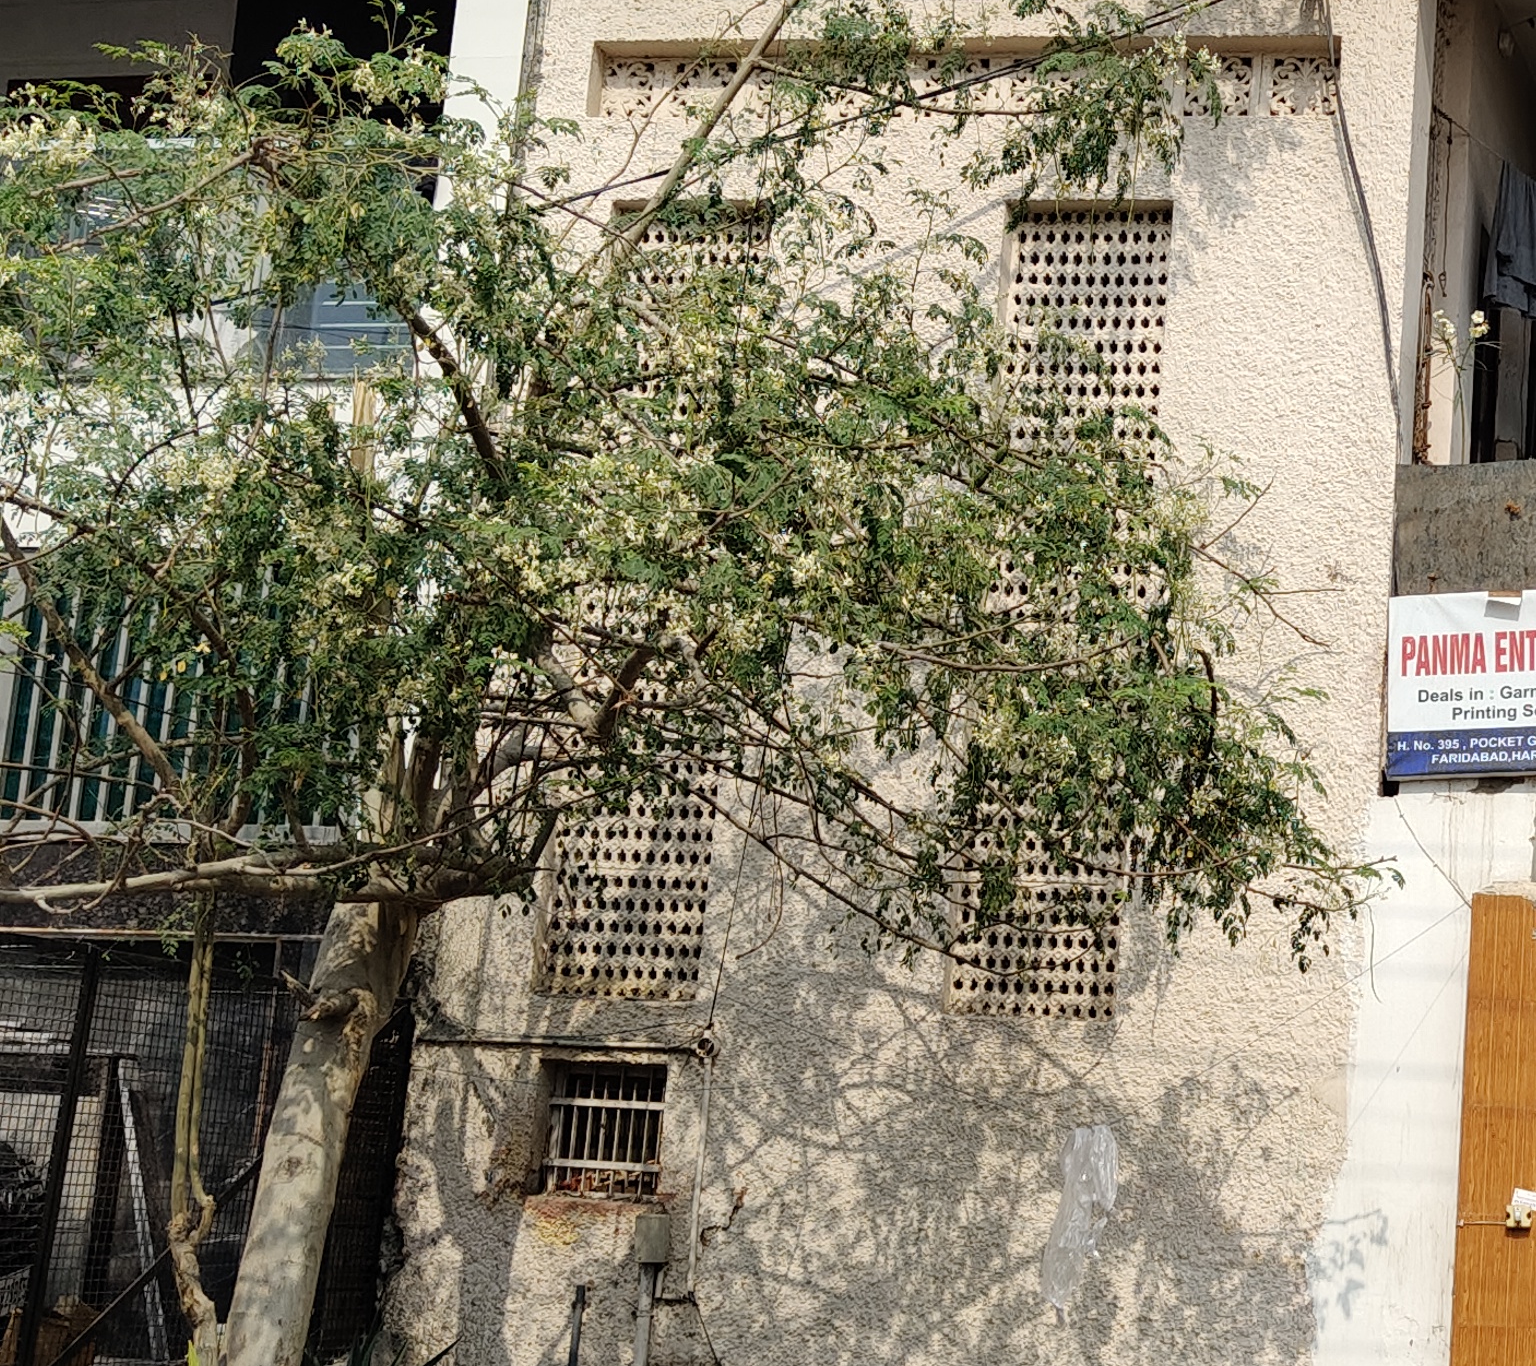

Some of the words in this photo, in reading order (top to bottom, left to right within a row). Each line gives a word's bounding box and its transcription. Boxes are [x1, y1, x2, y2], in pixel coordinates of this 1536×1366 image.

[1401, 632, 1487, 677] PANMA
[1418, 687, 1464, 703] Deals
[1469, 687, 1484, 701] in
[1452, 705, 1518, 722] Printing
[1396, 740, 1411, 751] H.
[1413, 739, 1435, 751] No.
[1437, 738, 1460, 750] 395
[1469, 736, 1524, 749] POCKET
